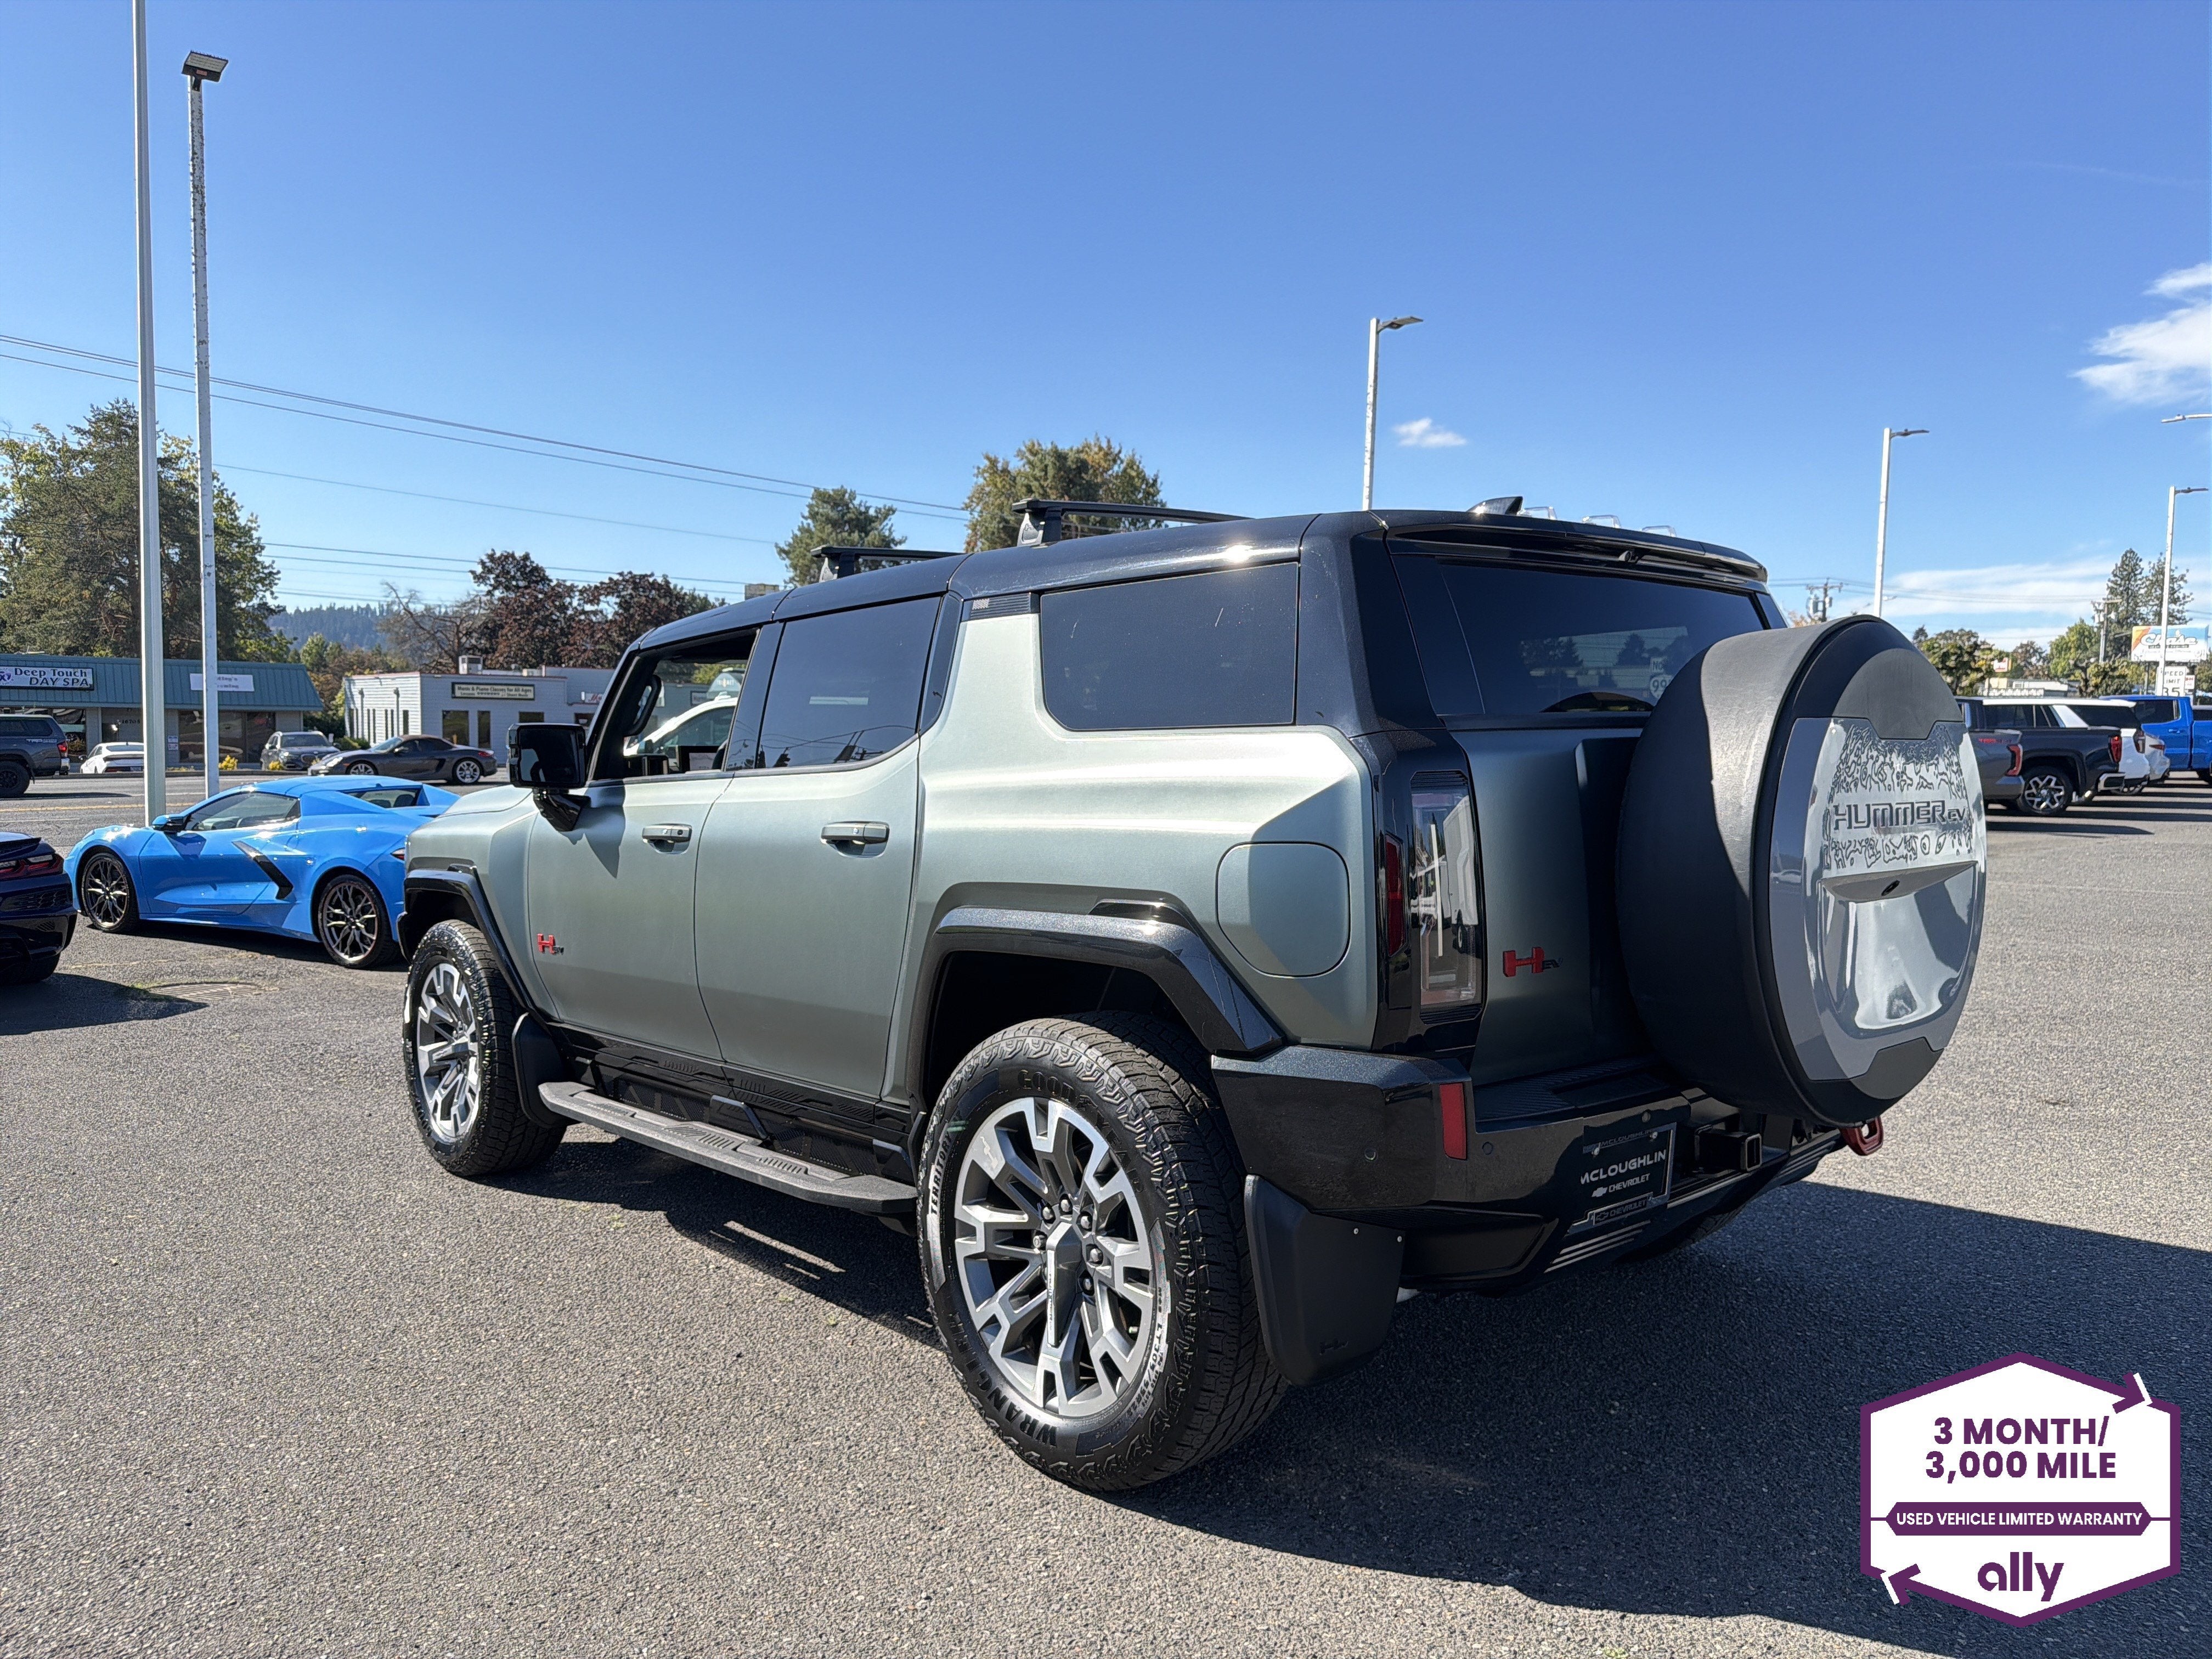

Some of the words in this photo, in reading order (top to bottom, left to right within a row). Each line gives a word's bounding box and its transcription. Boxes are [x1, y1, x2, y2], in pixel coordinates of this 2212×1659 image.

[15, 668, 46, 678] Deep
[50, 669, 87, 678] Touch
[29, 677, 59, 686] DAY
[63, 678, 89, 686] SPA
[1833, 800, 1946, 830] HUMMER
[930, 1131, 952, 1215] TERRITORY
[1609, 1173, 1650, 1193] CHEVROLET
